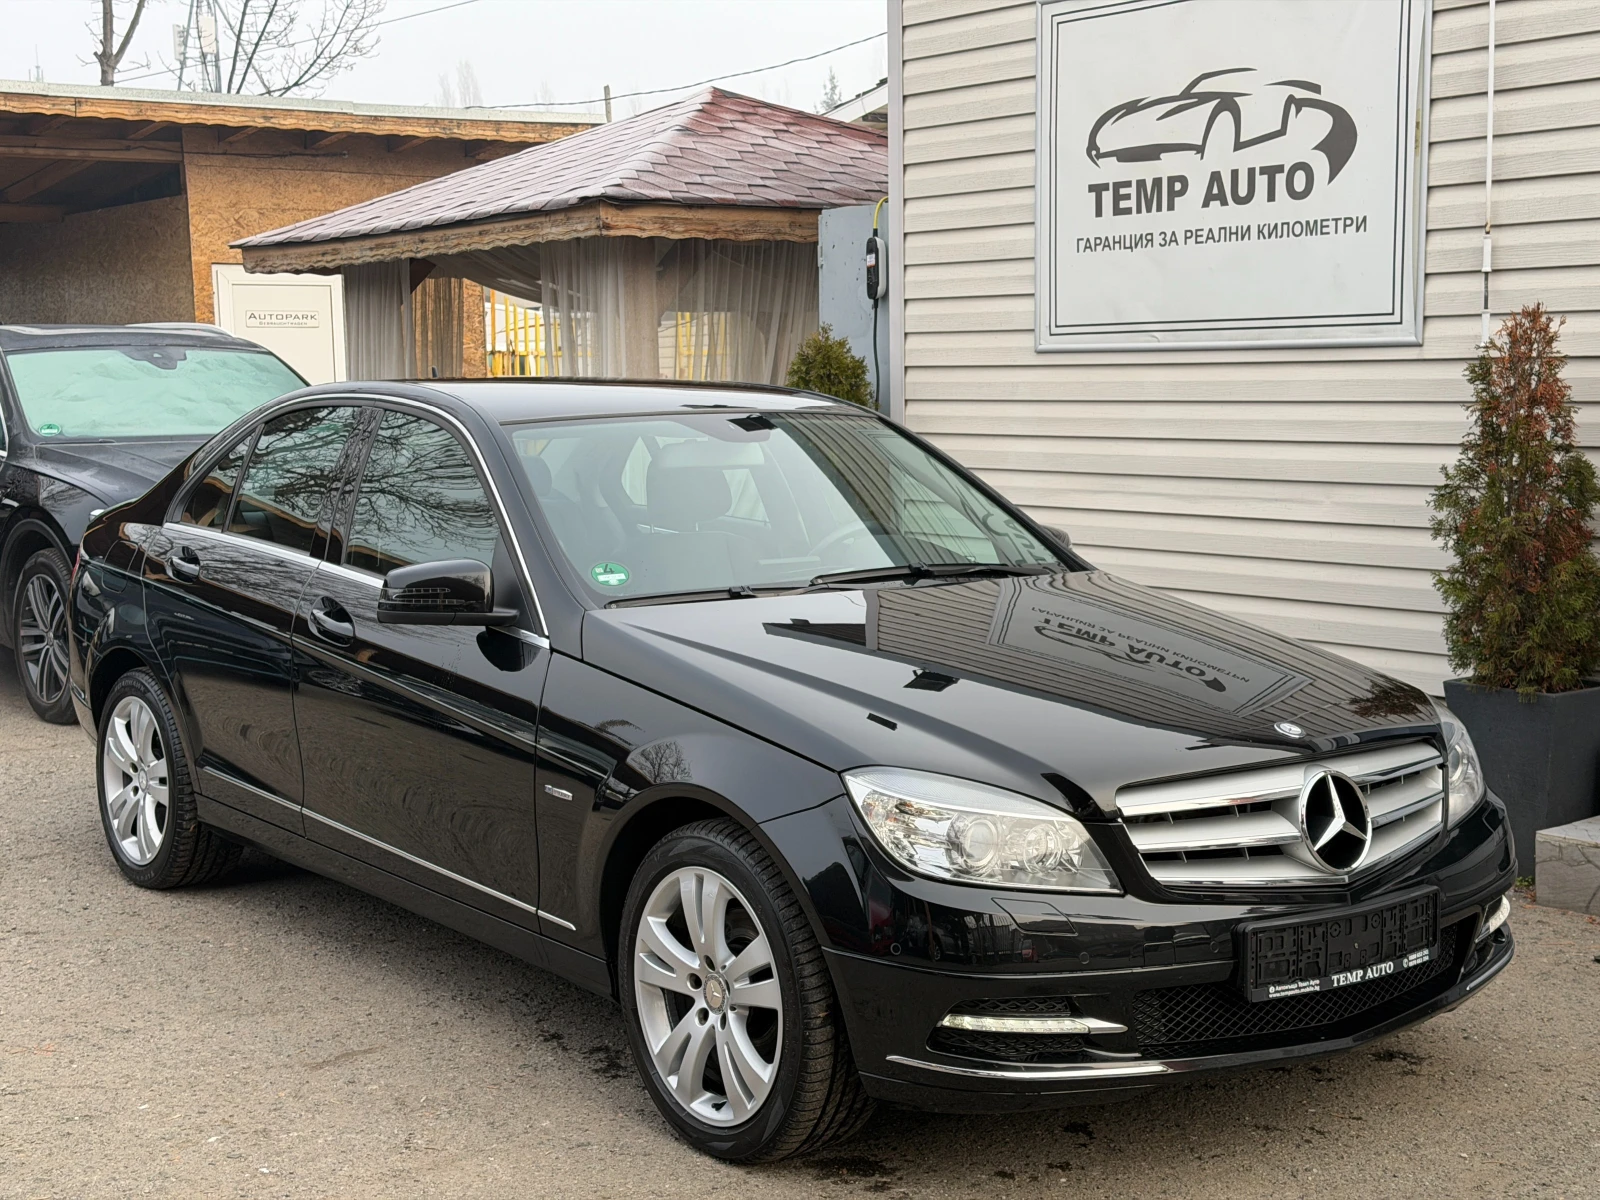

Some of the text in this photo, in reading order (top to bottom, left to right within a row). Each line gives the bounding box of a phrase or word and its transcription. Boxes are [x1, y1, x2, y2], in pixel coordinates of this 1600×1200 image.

[1088, 161, 1315, 218] TEMP AUTO
[1076, 215, 1368, 253] ГАРАНЦИЯ ЗА РЕАЛНИ КИЛОМЕТРИ
[248, 312, 317, 321] AUTOPARK
[1331, 961, 1394, 987] TEMP AUTO
